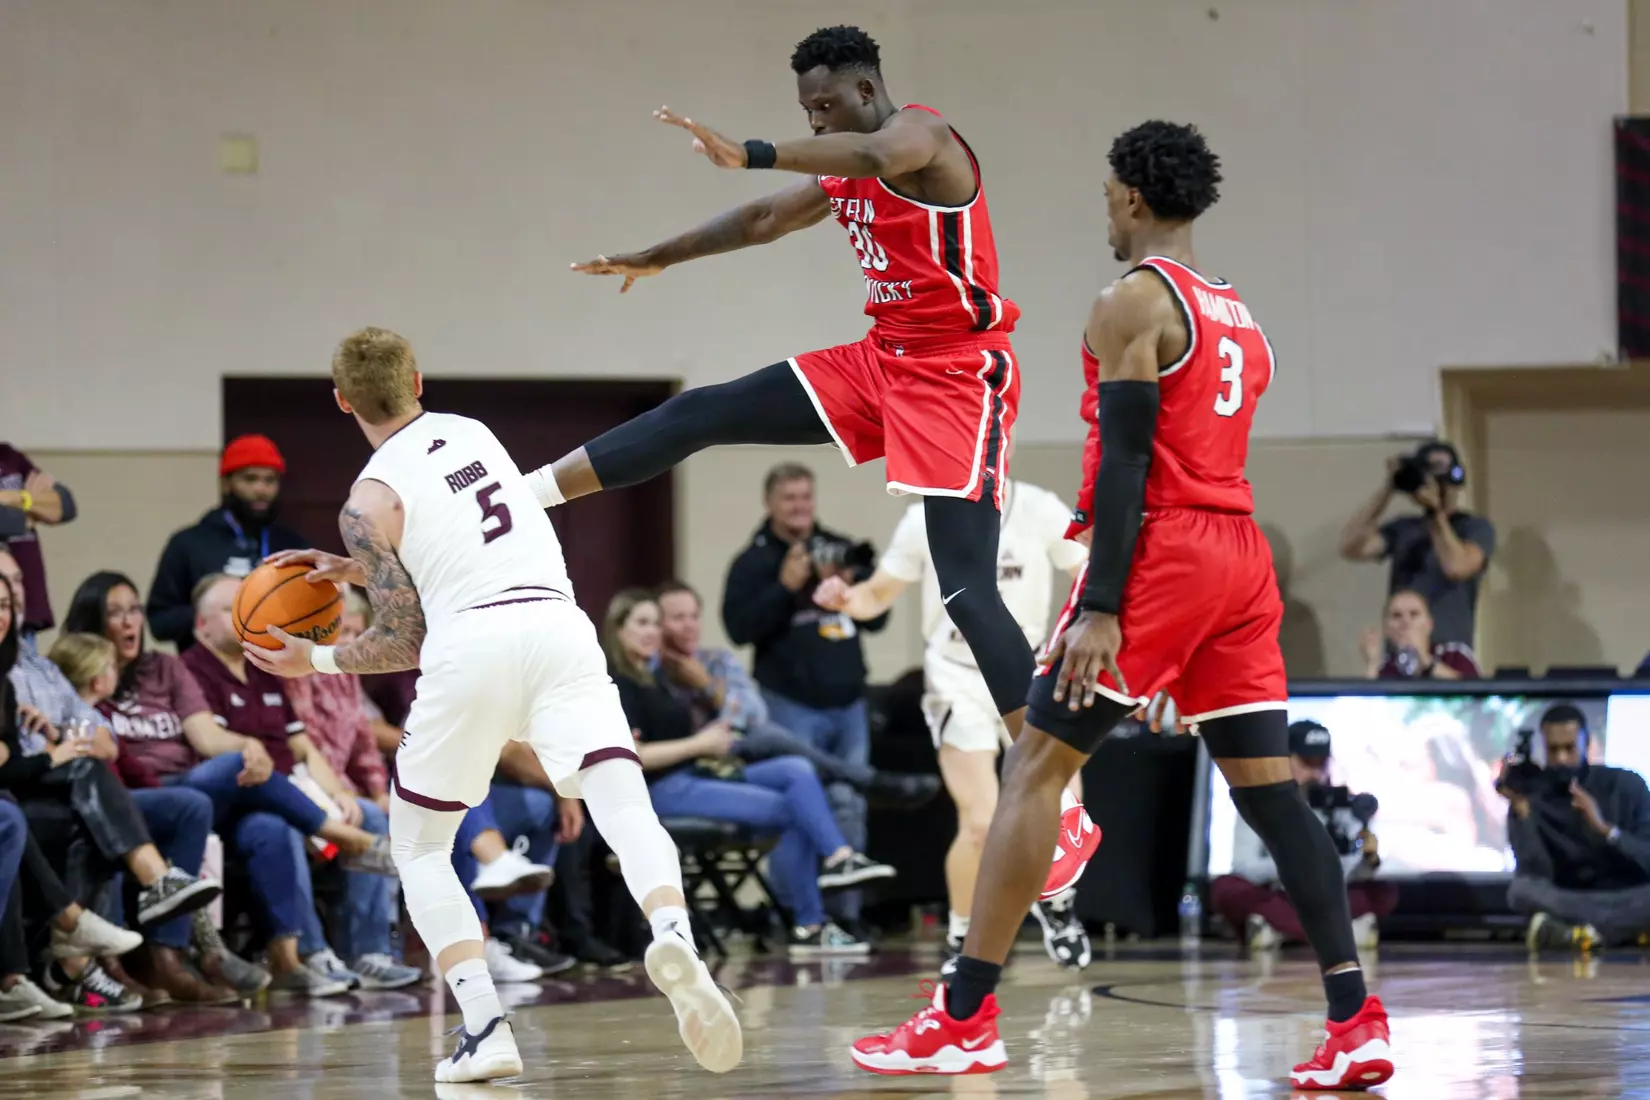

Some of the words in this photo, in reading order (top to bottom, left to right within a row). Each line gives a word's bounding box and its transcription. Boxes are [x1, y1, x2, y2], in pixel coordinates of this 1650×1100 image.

[1213, 335, 1244, 417] 3
[443, 460, 489, 494] ROBB
[475, 480, 513, 545] 5
